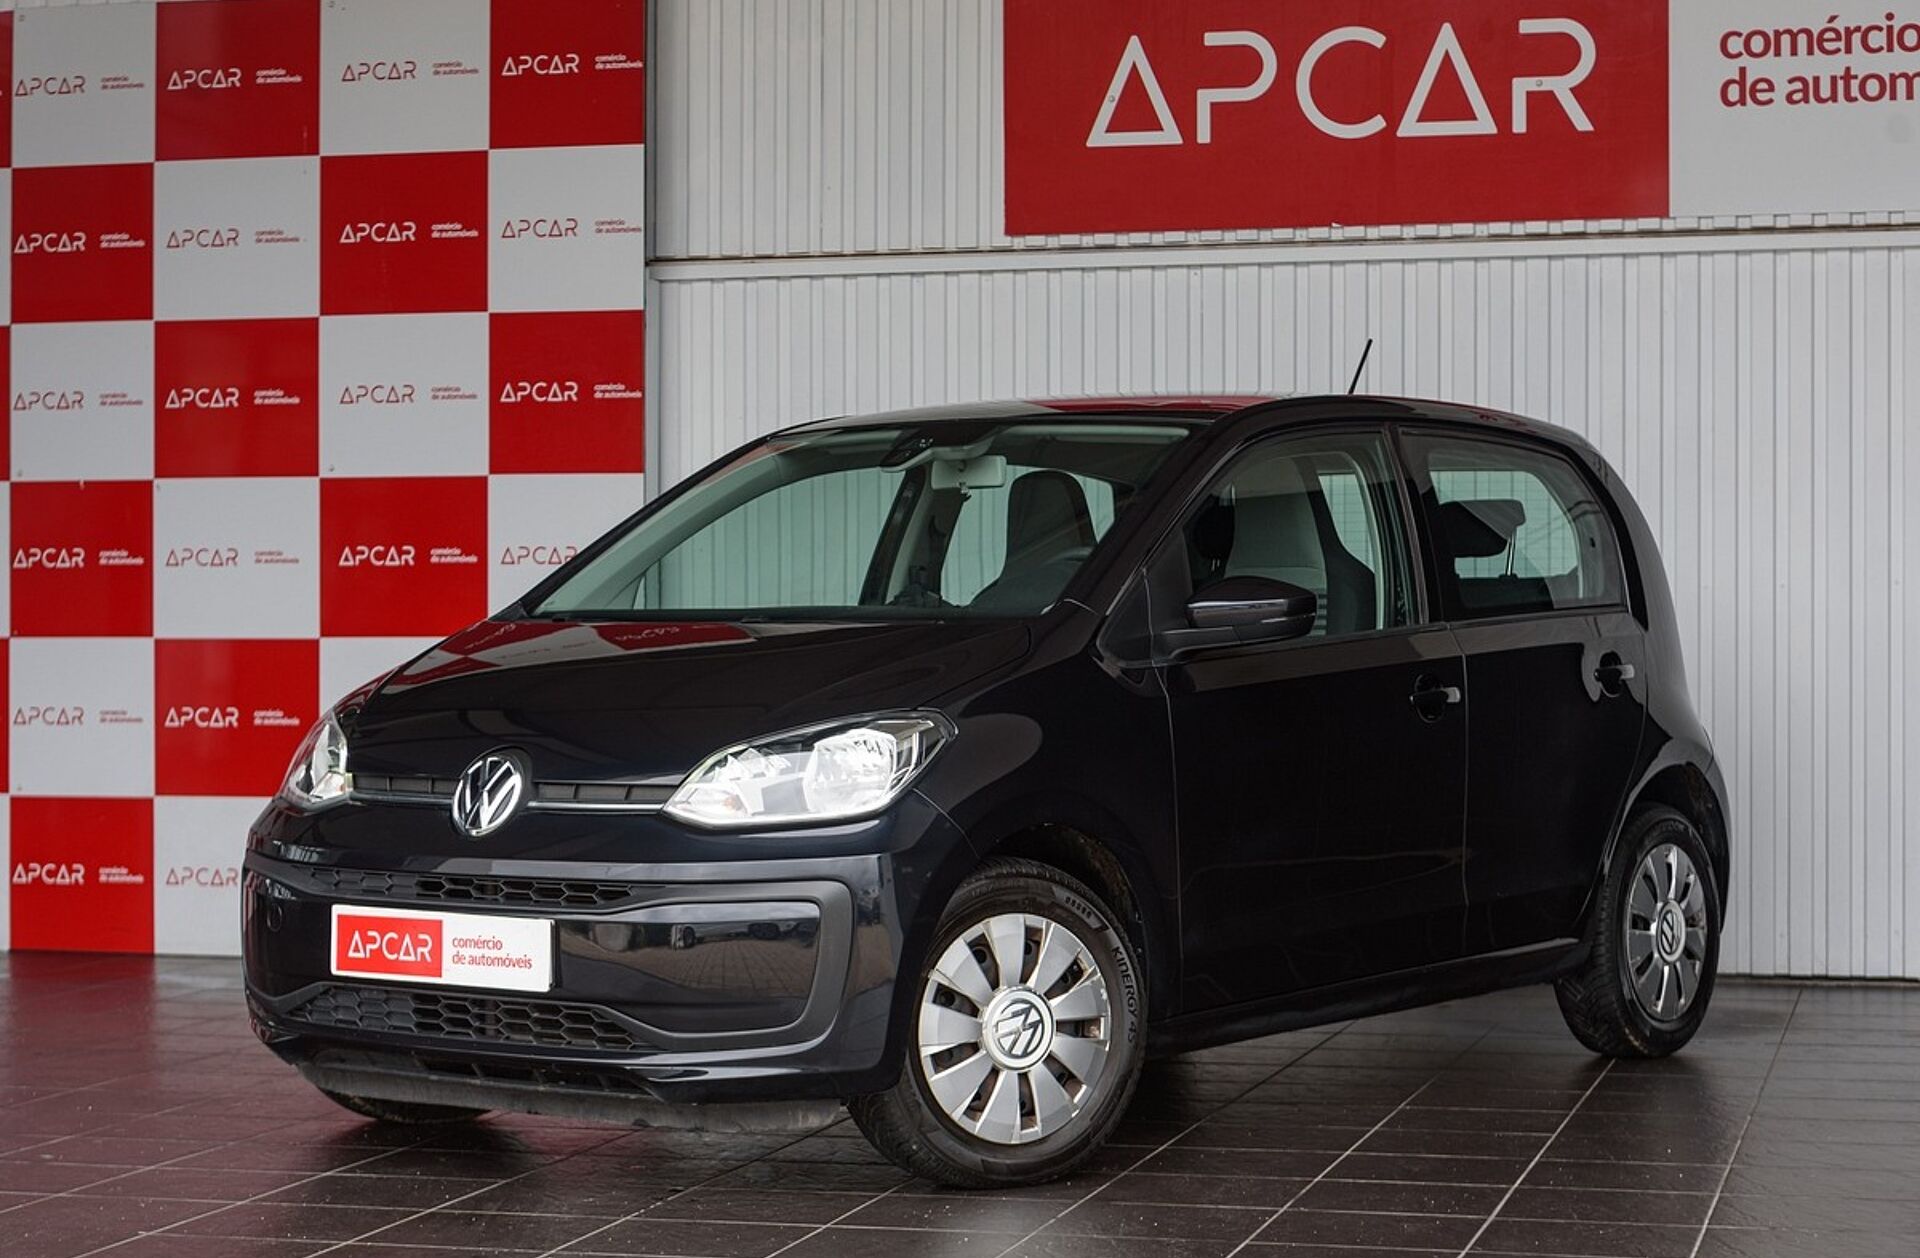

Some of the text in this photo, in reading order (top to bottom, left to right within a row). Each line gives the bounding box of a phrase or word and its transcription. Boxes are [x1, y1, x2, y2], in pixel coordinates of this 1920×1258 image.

[1720, 12, 1920, 60] comércio
[342, 61, 417, 82] APCAR
[502, 54, 580, 75] APCAR
[15, 76, 86, 96] APCAR
[168, 68, 242, 89] APCAR
[1087, 18, 1597, 147] APCAR
[1720, 66, 1775, 107] de
[340, 222, 417, 243] APCAR
[502, 218, 578, 238] APCAR
[14, 232, 87, 253] APCAR
[167, 229, 240, 248] APCAR
[12, 391, 85, 410] APCAR
[165, 388, 240, 408] APCAR
[340, 385, 415, 404] APCAR
[500, 382, 579, 402] APCAR
[13, 548, 86, 568] APCAR
[166, 548, 239, 566] APCAR
[339, 546, 416, 566] APCAR
[13, 707, 85, 725] APCAR
[165, 707, 239, 727] APCAR
[13, 863, 85, 884] APCAR
[166, 867, 238, 886] APCAR
[348, 930, 433, 962] APCAR
[452, 936, 503, 951] comércio
[452, 951, 533, 970] de automóveis
